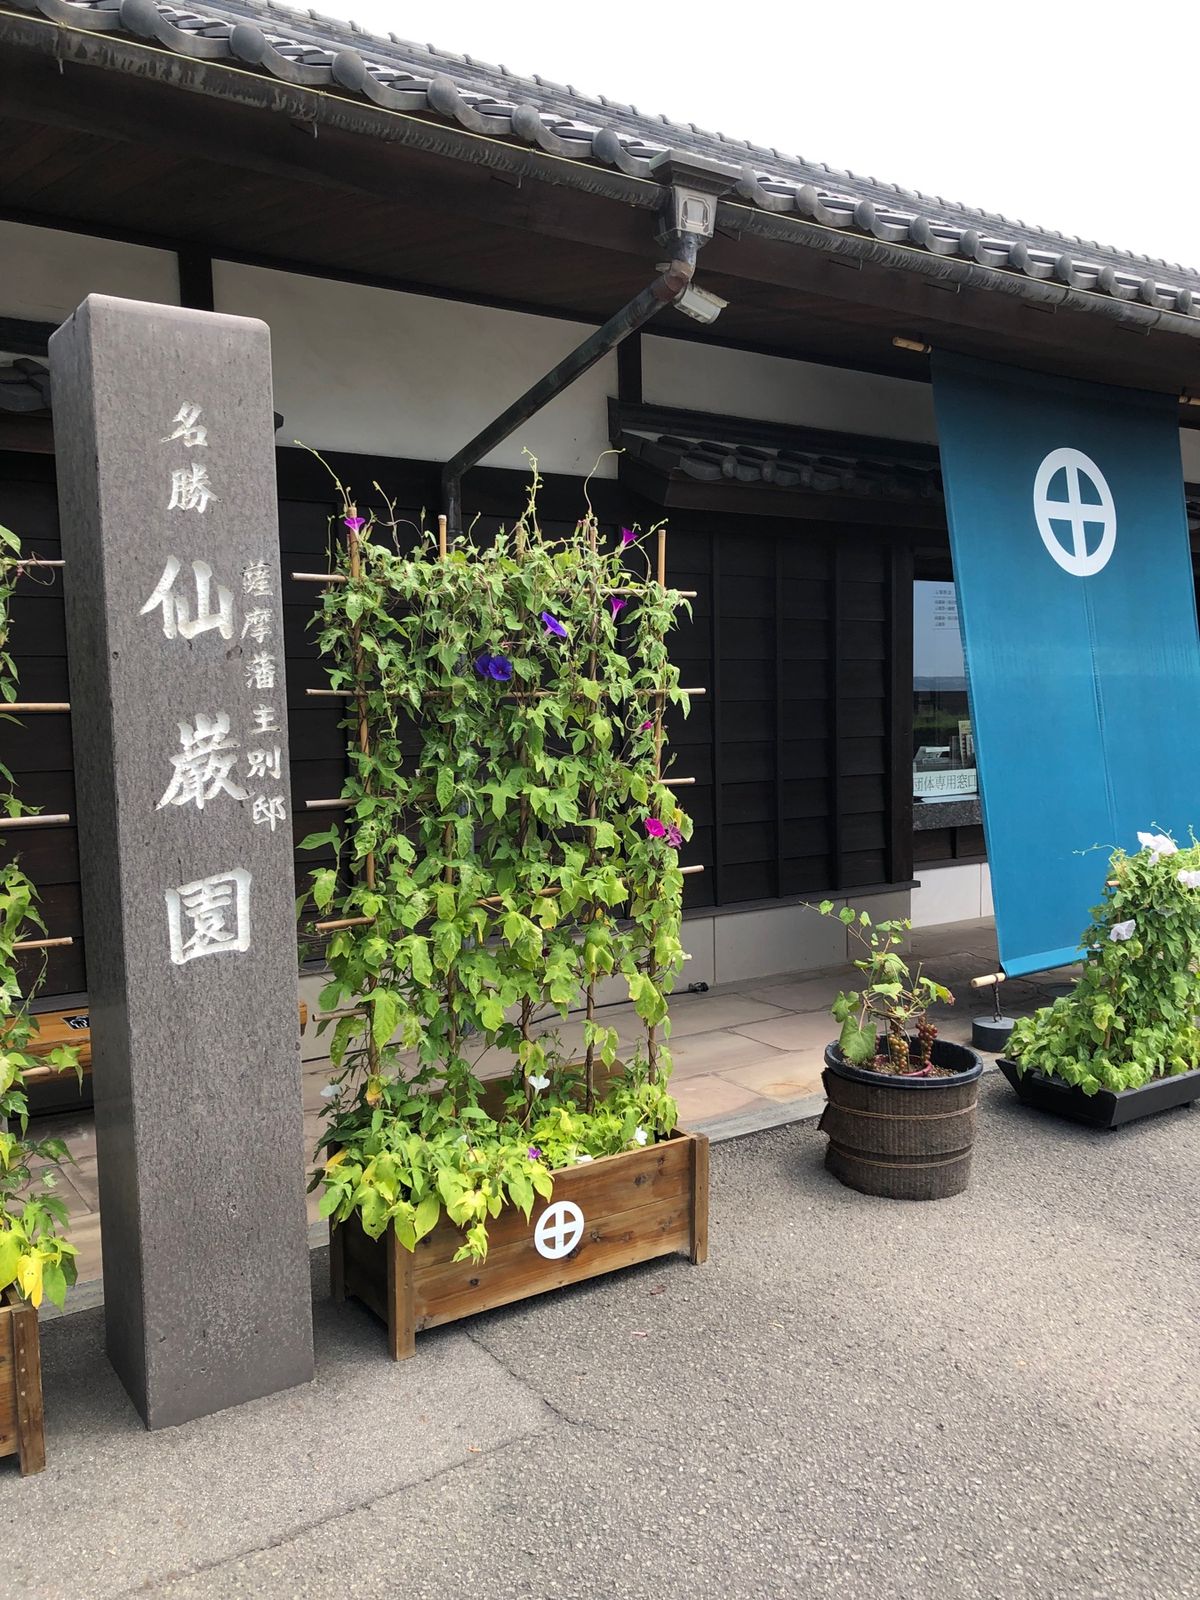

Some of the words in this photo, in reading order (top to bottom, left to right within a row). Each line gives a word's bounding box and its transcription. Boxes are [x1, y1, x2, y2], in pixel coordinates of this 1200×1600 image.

[160, 402, 221, 513] 名勝
[240, 559, 286, 831] 薩摩藩主別邸
[913, 774, 977, 792] 団体専用窓口
